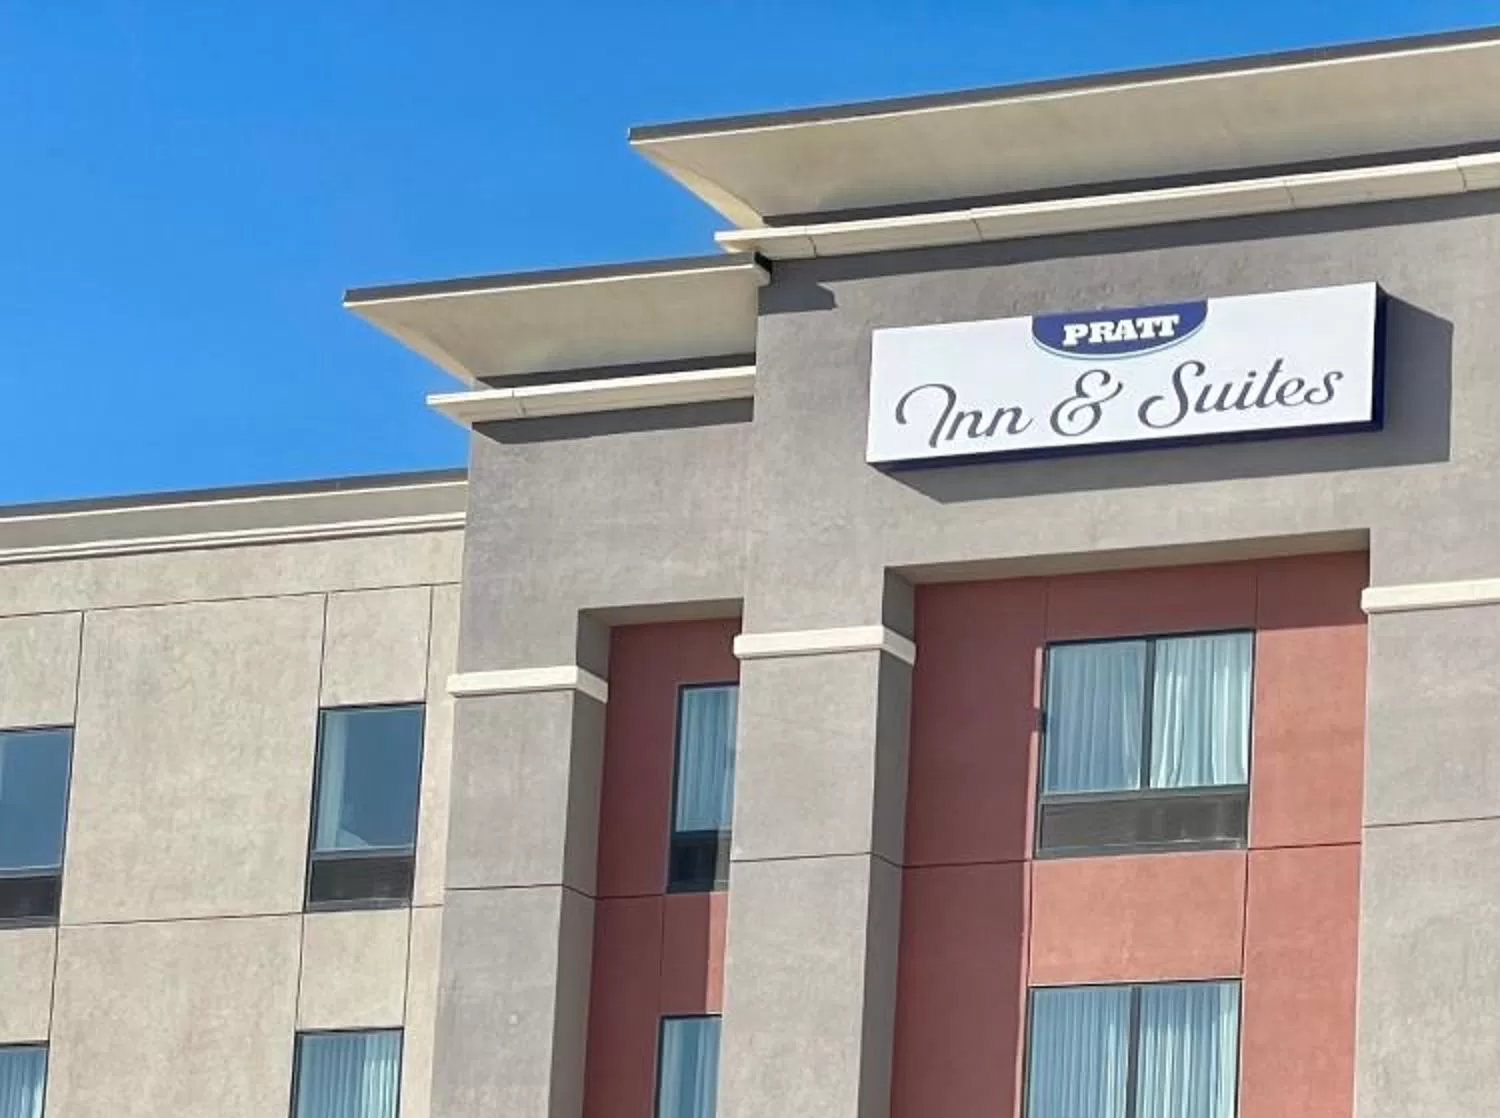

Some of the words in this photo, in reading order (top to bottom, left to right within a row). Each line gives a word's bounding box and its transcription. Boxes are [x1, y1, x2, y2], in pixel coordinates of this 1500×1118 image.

[1062, 313, 1180, 347] PRATT
[896, 383, 1034, 449] Inn
[1049, 368, 1124, 437] &
[1138, 358, 1344, 429] Suites
